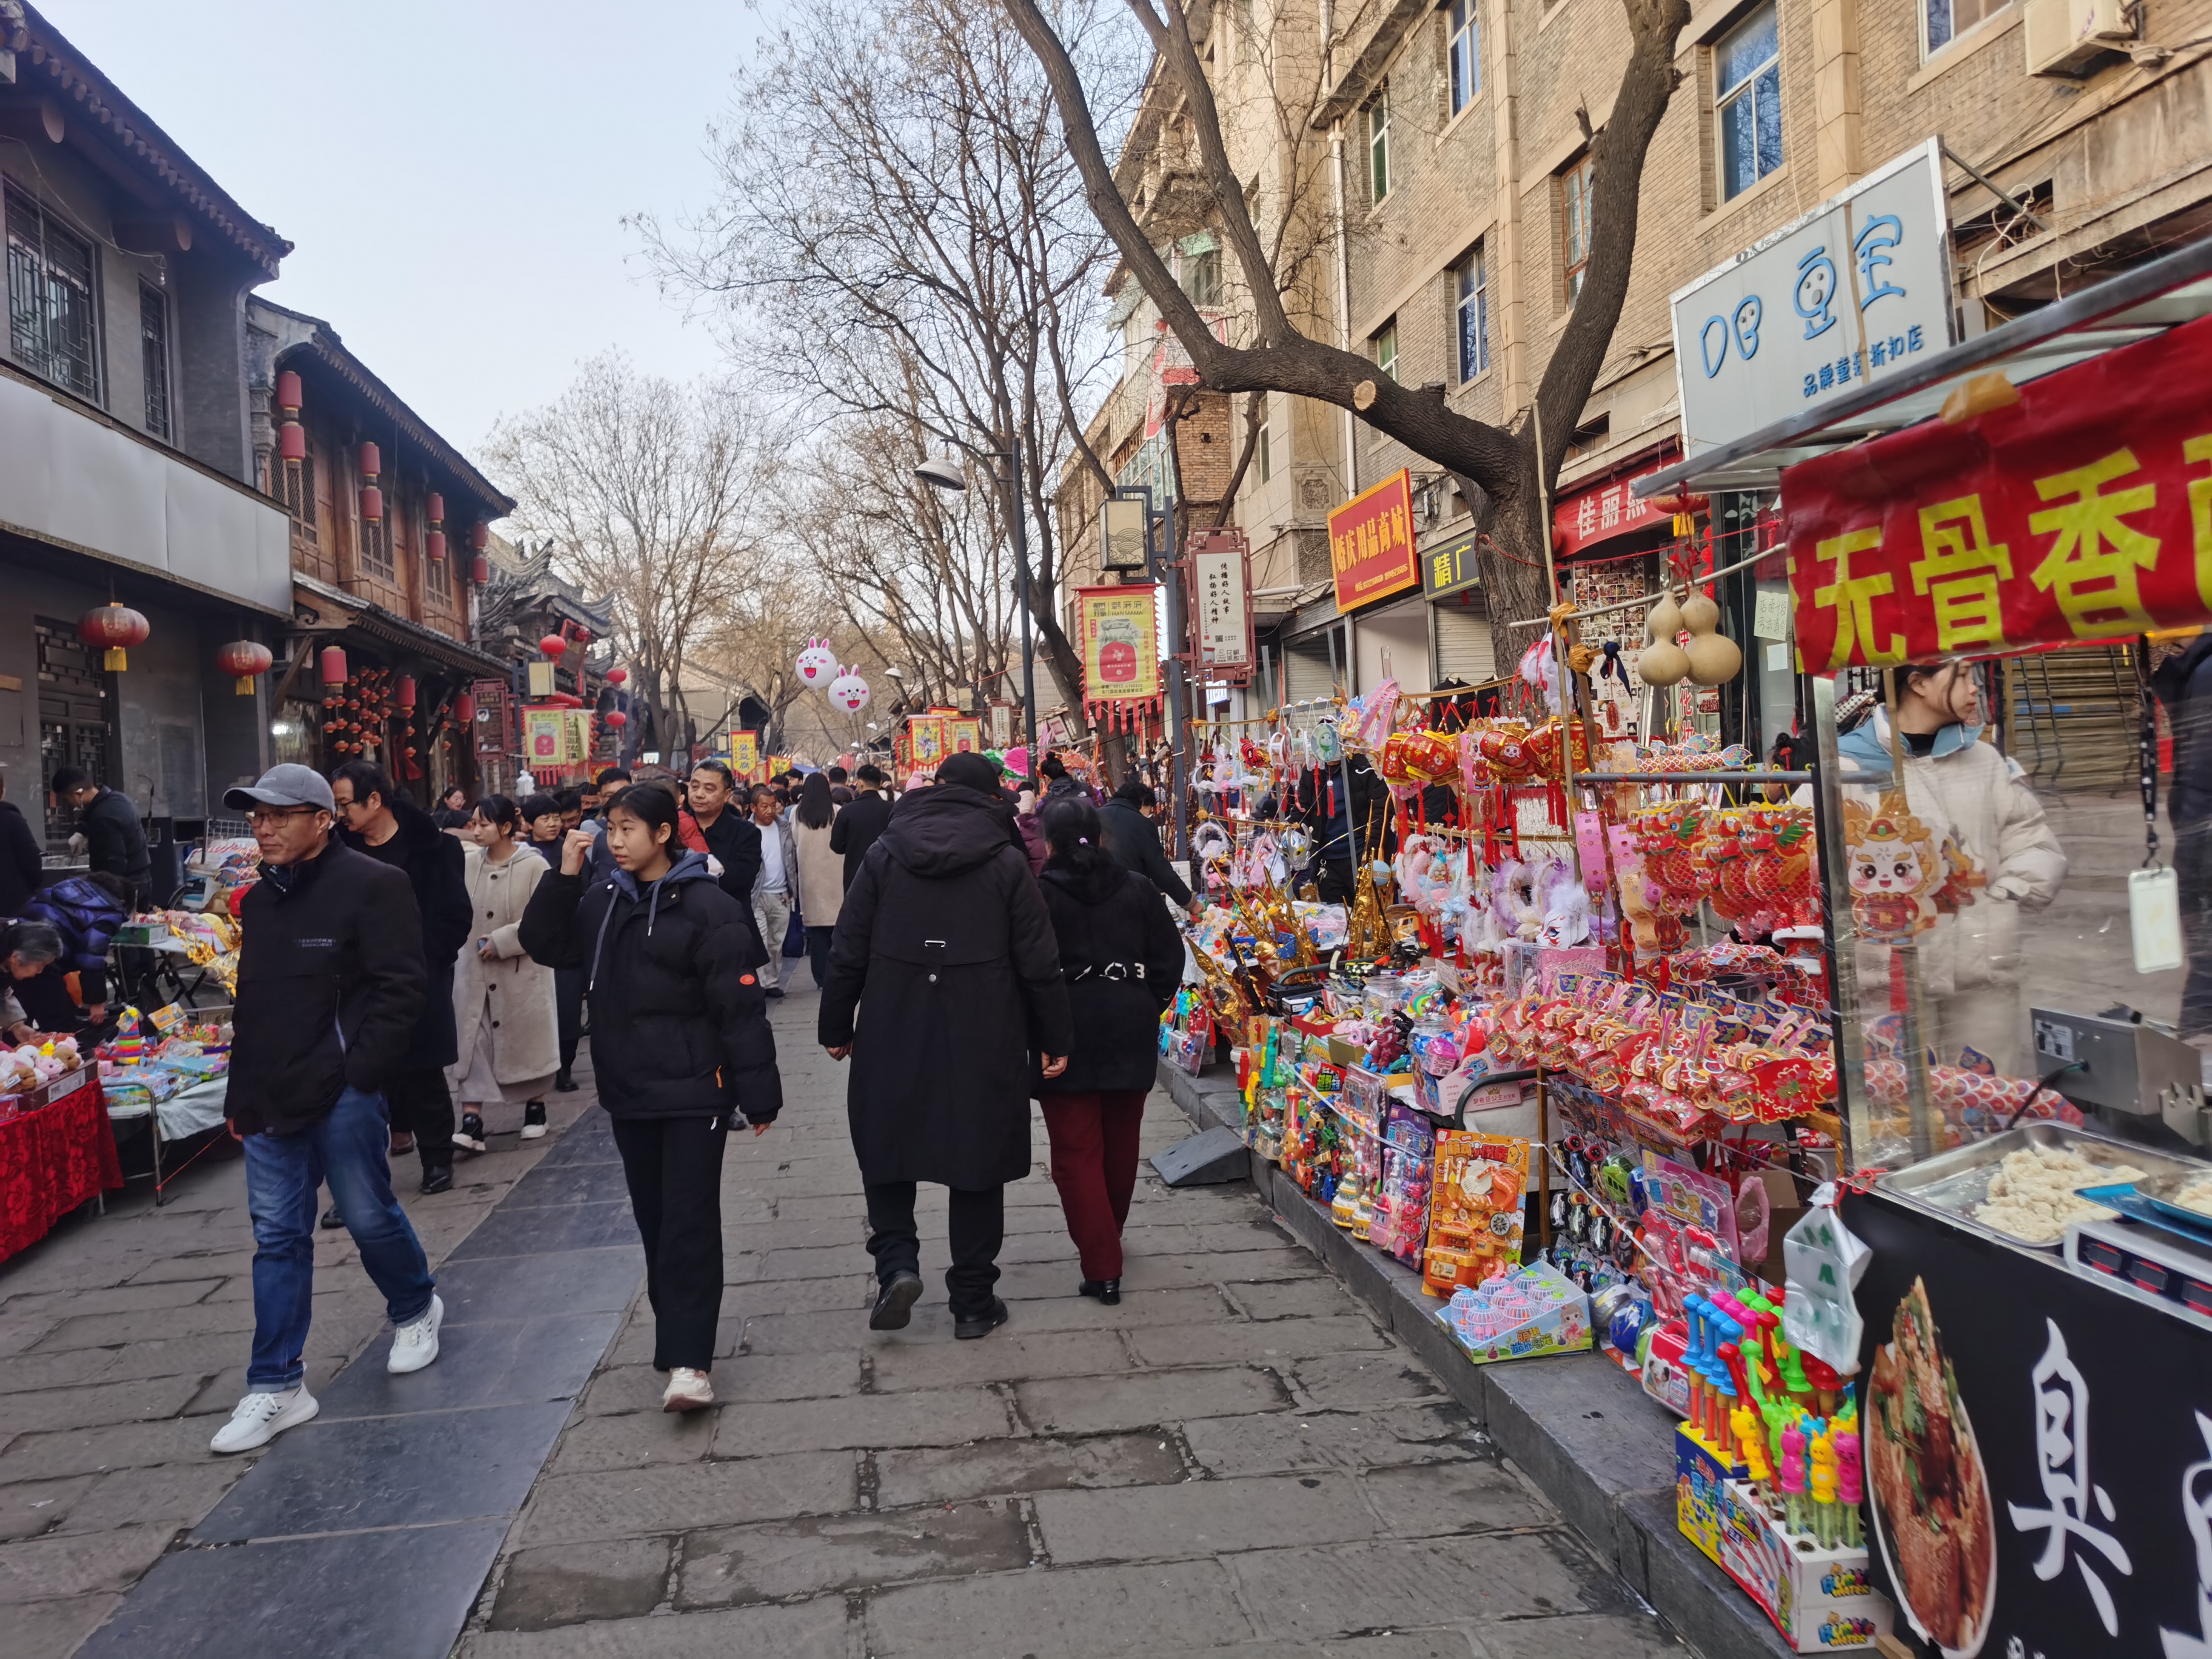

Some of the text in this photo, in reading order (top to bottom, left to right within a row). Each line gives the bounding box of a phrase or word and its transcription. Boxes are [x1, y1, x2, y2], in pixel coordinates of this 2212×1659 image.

[1335, 504, 1406, 574] 婚庆用品商城
[1786, 433, 2212, 674] 无骨香
